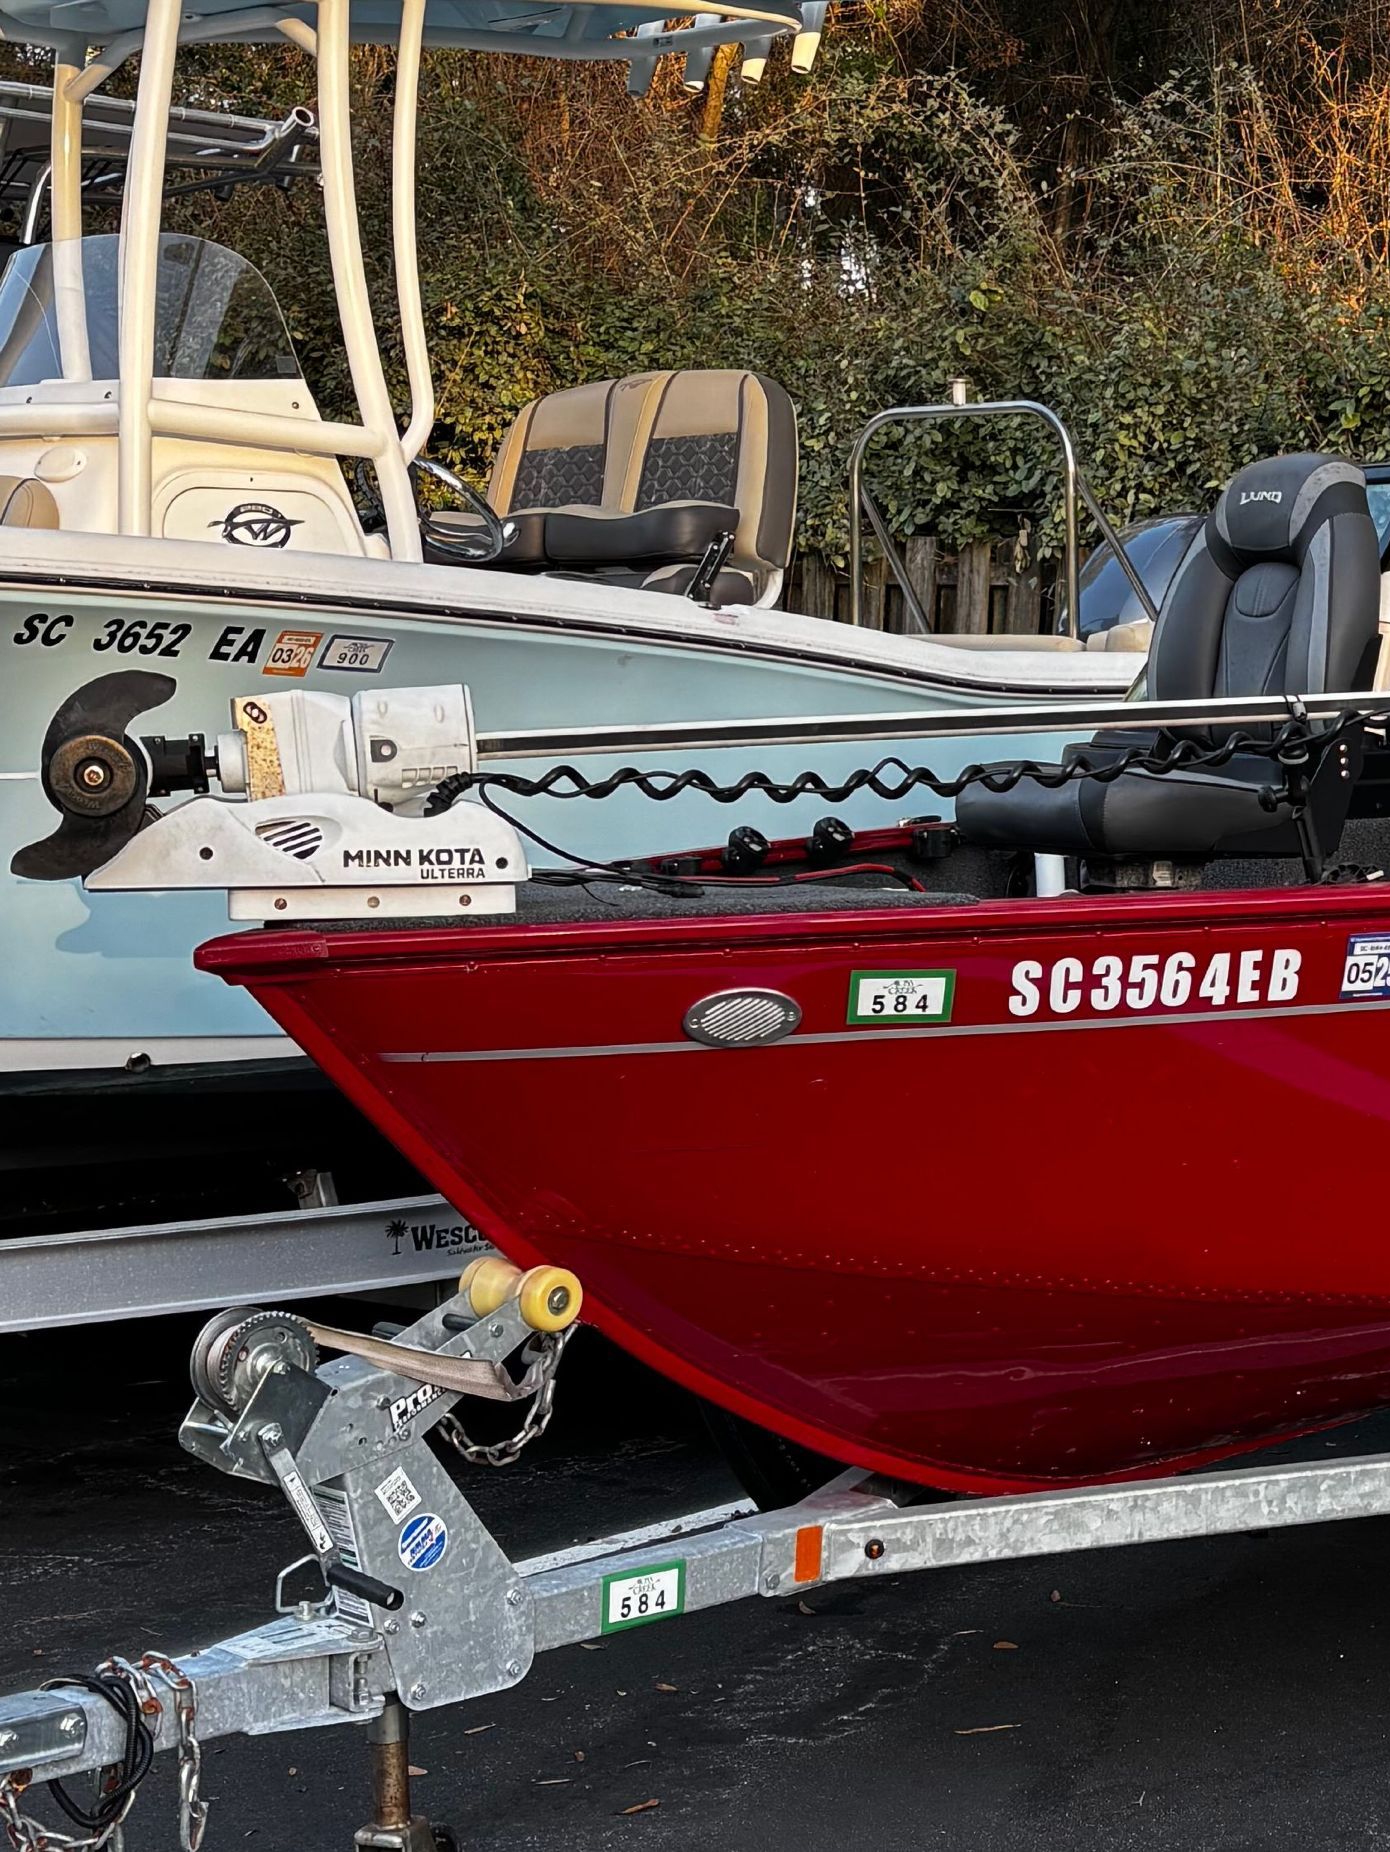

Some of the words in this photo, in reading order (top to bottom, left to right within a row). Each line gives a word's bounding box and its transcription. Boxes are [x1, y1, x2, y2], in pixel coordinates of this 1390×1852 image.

[1240, 491, 1282, 505] LUND
[13, 613, 74, 647] SC
[92, 618, 192, 658] 3652
[208, 626, 267, 664] EA
[272, 648, 294, 664] 03
[336, 652, 370, 666] 900
[343, 849, 411, 868] MINN
[418, 848, 485, 866] KOTA
[420, 867, 486, 880] ULTERRA
[1008, 949, 1302, 1017] SC3564EB
[1347, 962, 1374, 984] 05
[871, 994, 928, 1014] 584
[620, 1589, 666, 1618] 584
